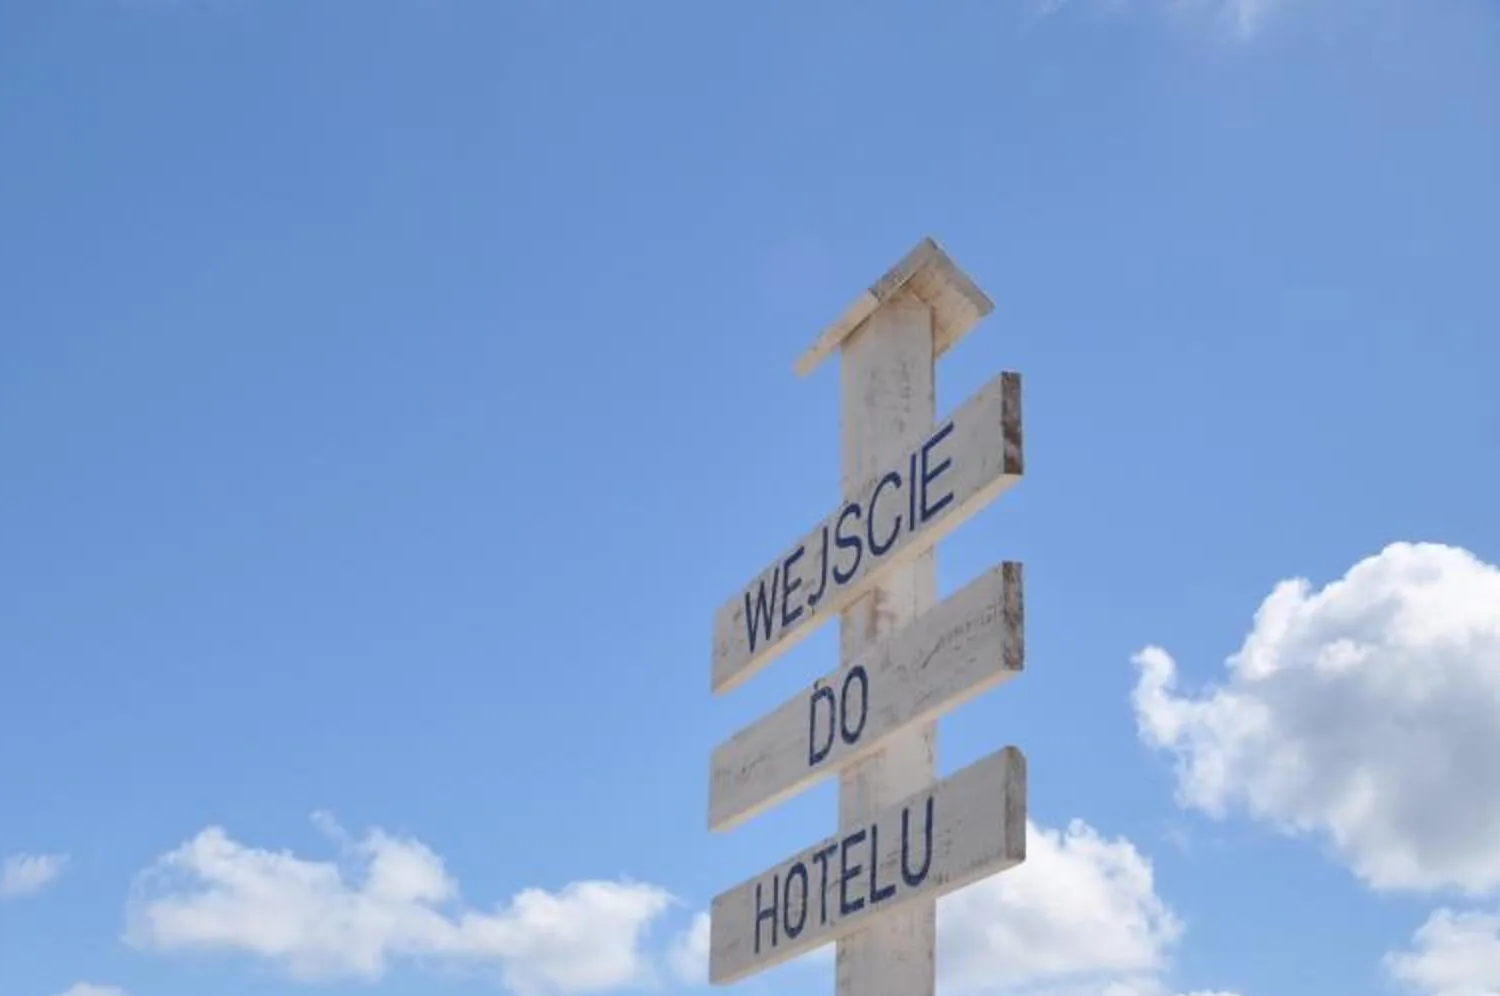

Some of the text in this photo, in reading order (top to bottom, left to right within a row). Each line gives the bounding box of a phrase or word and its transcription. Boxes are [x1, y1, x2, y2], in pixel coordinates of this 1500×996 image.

[745, 422, 954, 652] WEJSCIE
[809, 665, 868, 766] DO
[754, 797, 934, 954] HOTELU
